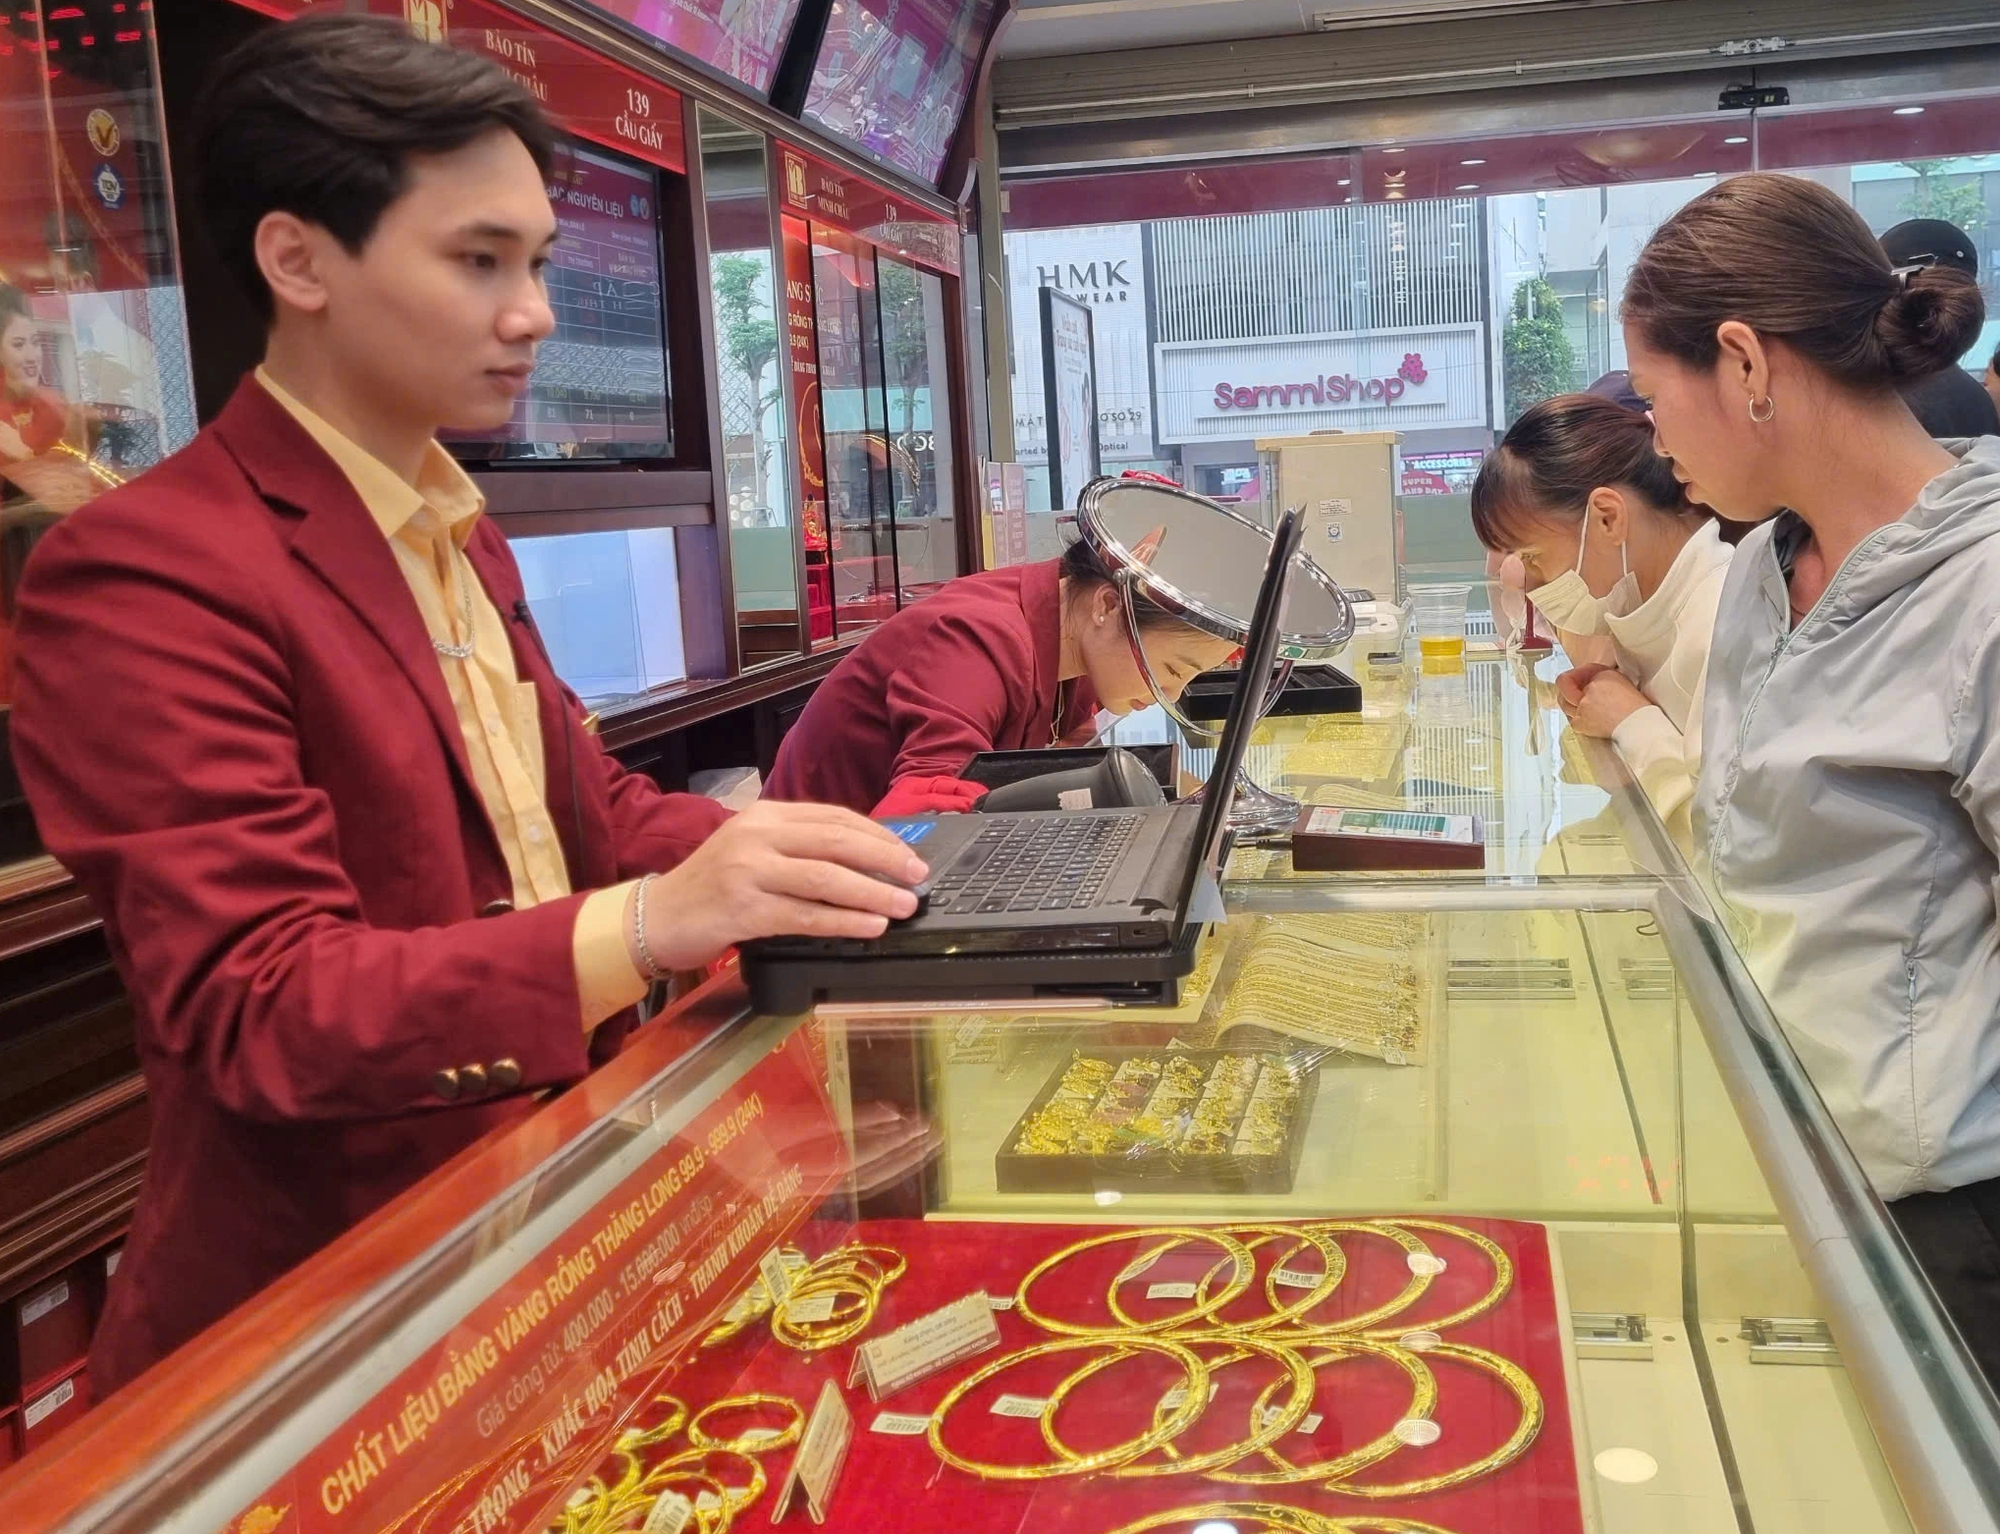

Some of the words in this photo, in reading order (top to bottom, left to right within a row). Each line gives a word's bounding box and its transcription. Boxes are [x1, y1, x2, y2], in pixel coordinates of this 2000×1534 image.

[485, 28, 513, 57] BẢO
[514, 40, 536, 68] TÍN
[627, 88, 650, 117] 139
[615, 109, 637, 140] CẦU
[639, 122, 663, 150] GIẤY
[821, 178, 834, 194] BẢO
[834, 181, 844, 198] TÍN
[567, 190, 604, 213] NGUYÊN
[605, 200, 624, 219] LIỆU
[817, 196, 834, 215] MINH
[885, 203, 897, 222] 139
[1036, 260, 1131, 289] HMK
[1214, 374, 1405, 409] SammiShop
[1414, 458, 1473, 469] ACCESSORIES
[1402, 478, 1433, 486] SUPER
[322, 1430, 388, 1515] CHẤT
[387, 1387, 441, 1455] LIỆU
[437, 1336, 498, 1409] BẰNG
[494, 1289, 549, 1352] VÀNG
[546, 1245, 596, 1307] RỒNG
[591, 1202, 645, 1262] THĂNG
[642, 1167, 682, 1218] LONG
[678, 1145, 705, 1183] 99.9
[708, 1115, 737, 1155] 999.9
[735, 1091, 764, 1136] (24K)
[469, 1458, 530, 1534] TRỌNG
[541, 1393, 585, 1464] KHẮC
[615, 1326, 651, 1380] TÍNH
[651, 1293, 684, 1343] CÁCH
[689, 1240, 730, 1299] THANH
[726, 1204, 765, 1258] KHOẢN
[761, 1178, 779, 1219] DỄ
[776, 1162, 804, 1204] DÀNG
[477, 1395, 506, 1438] Giá
[505, 1364, 546, 1412] công
[541, 1341, 564, 1374] từ:
[563, 1288, 614, 1352] 400.000
